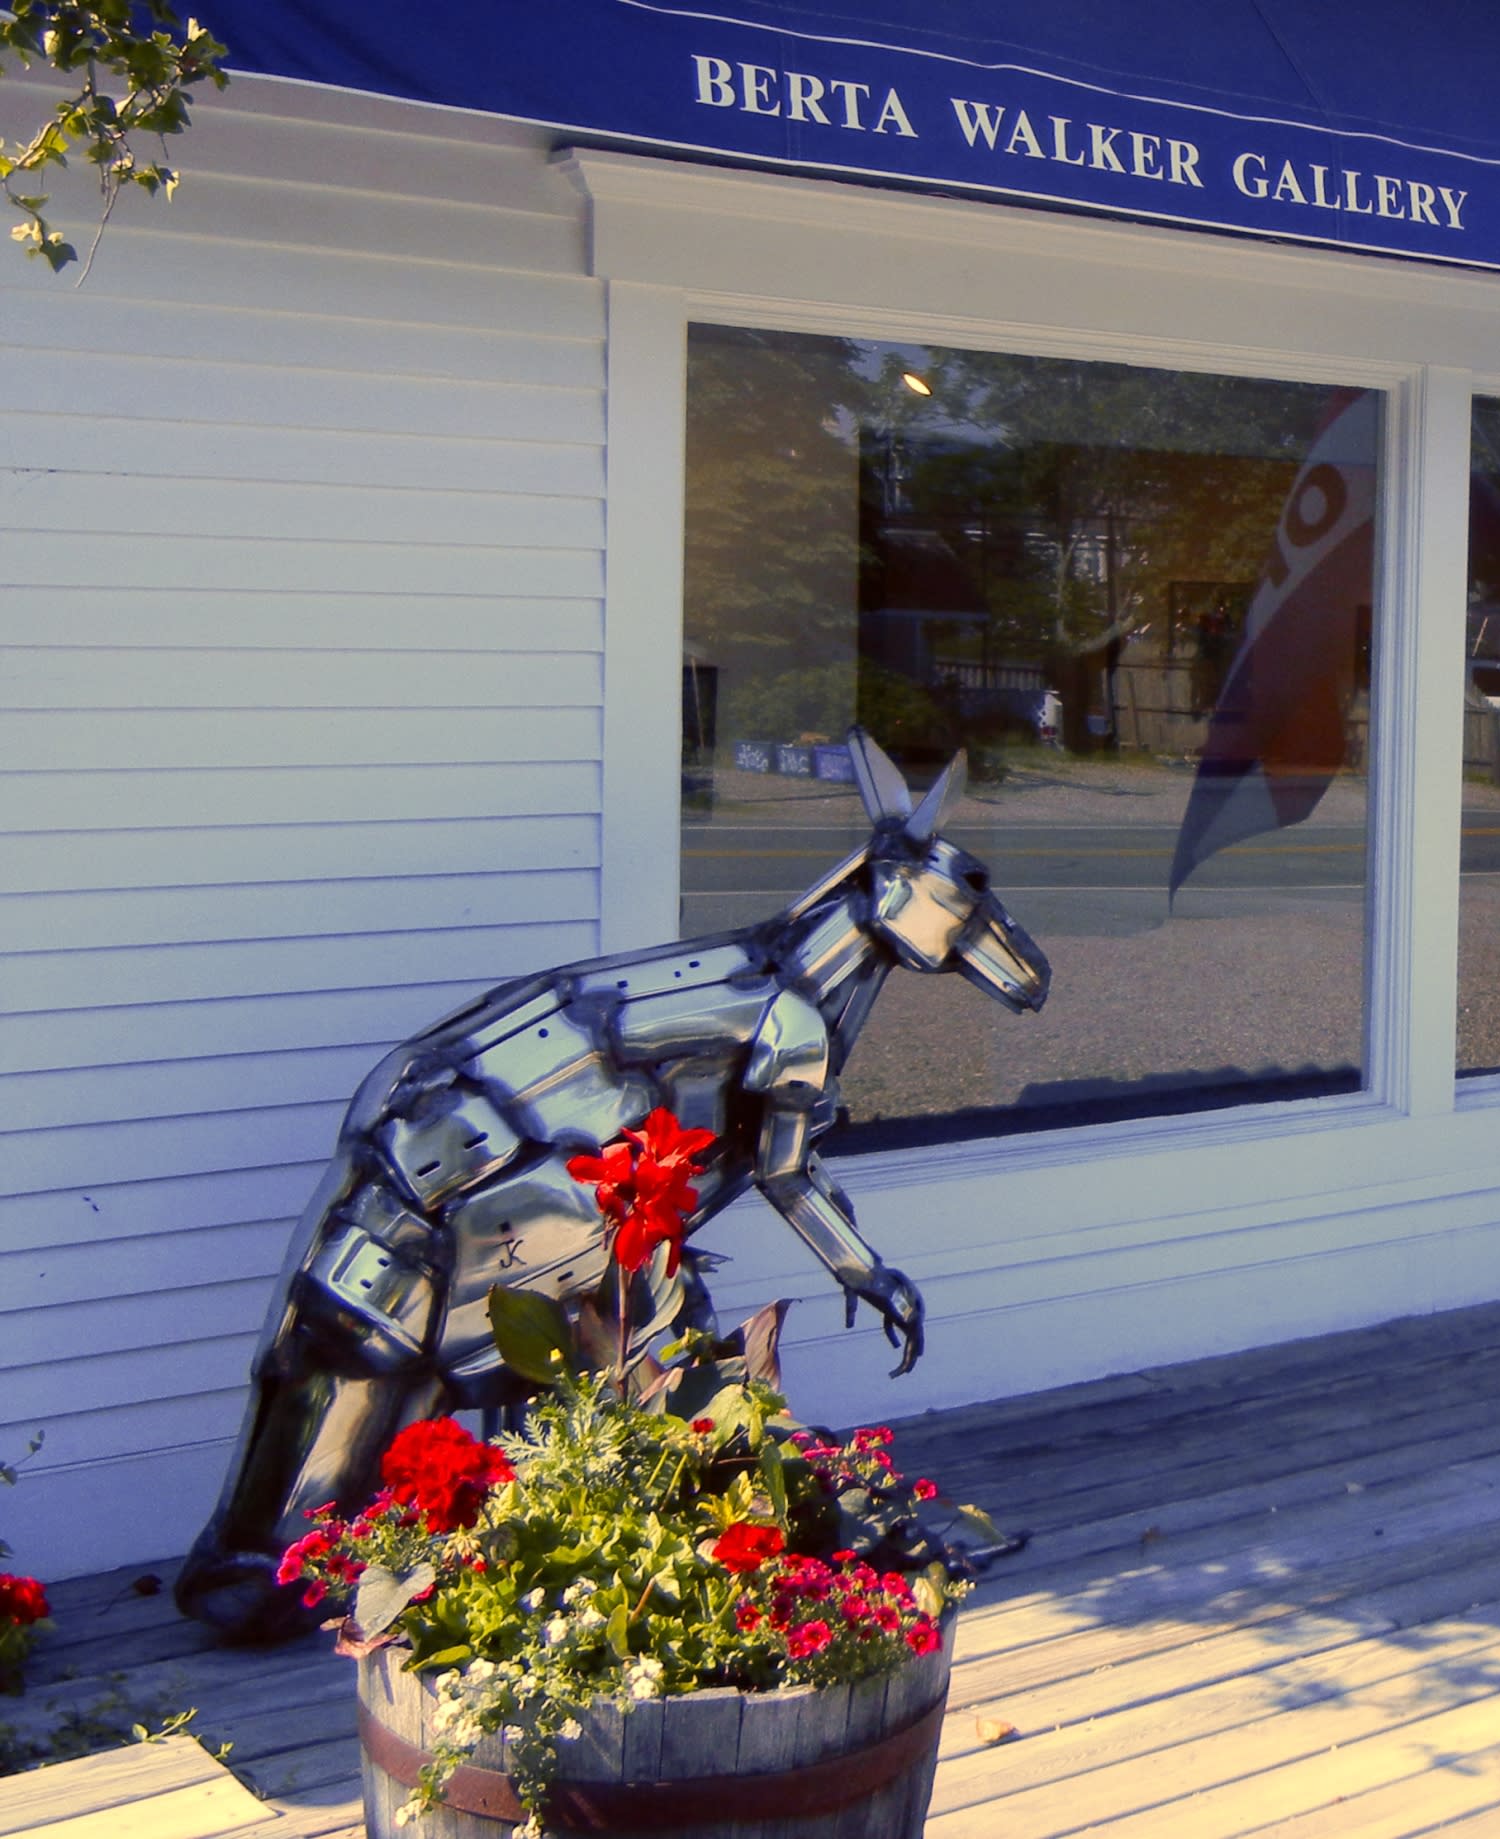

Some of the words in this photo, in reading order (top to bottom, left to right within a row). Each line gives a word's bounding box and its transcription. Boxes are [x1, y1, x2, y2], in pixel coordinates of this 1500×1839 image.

[690, 54, 918, 138] BERTA
[950, 98, 1205, 188] WALKER
[1232, 153, 1467, 230] GALLERY
